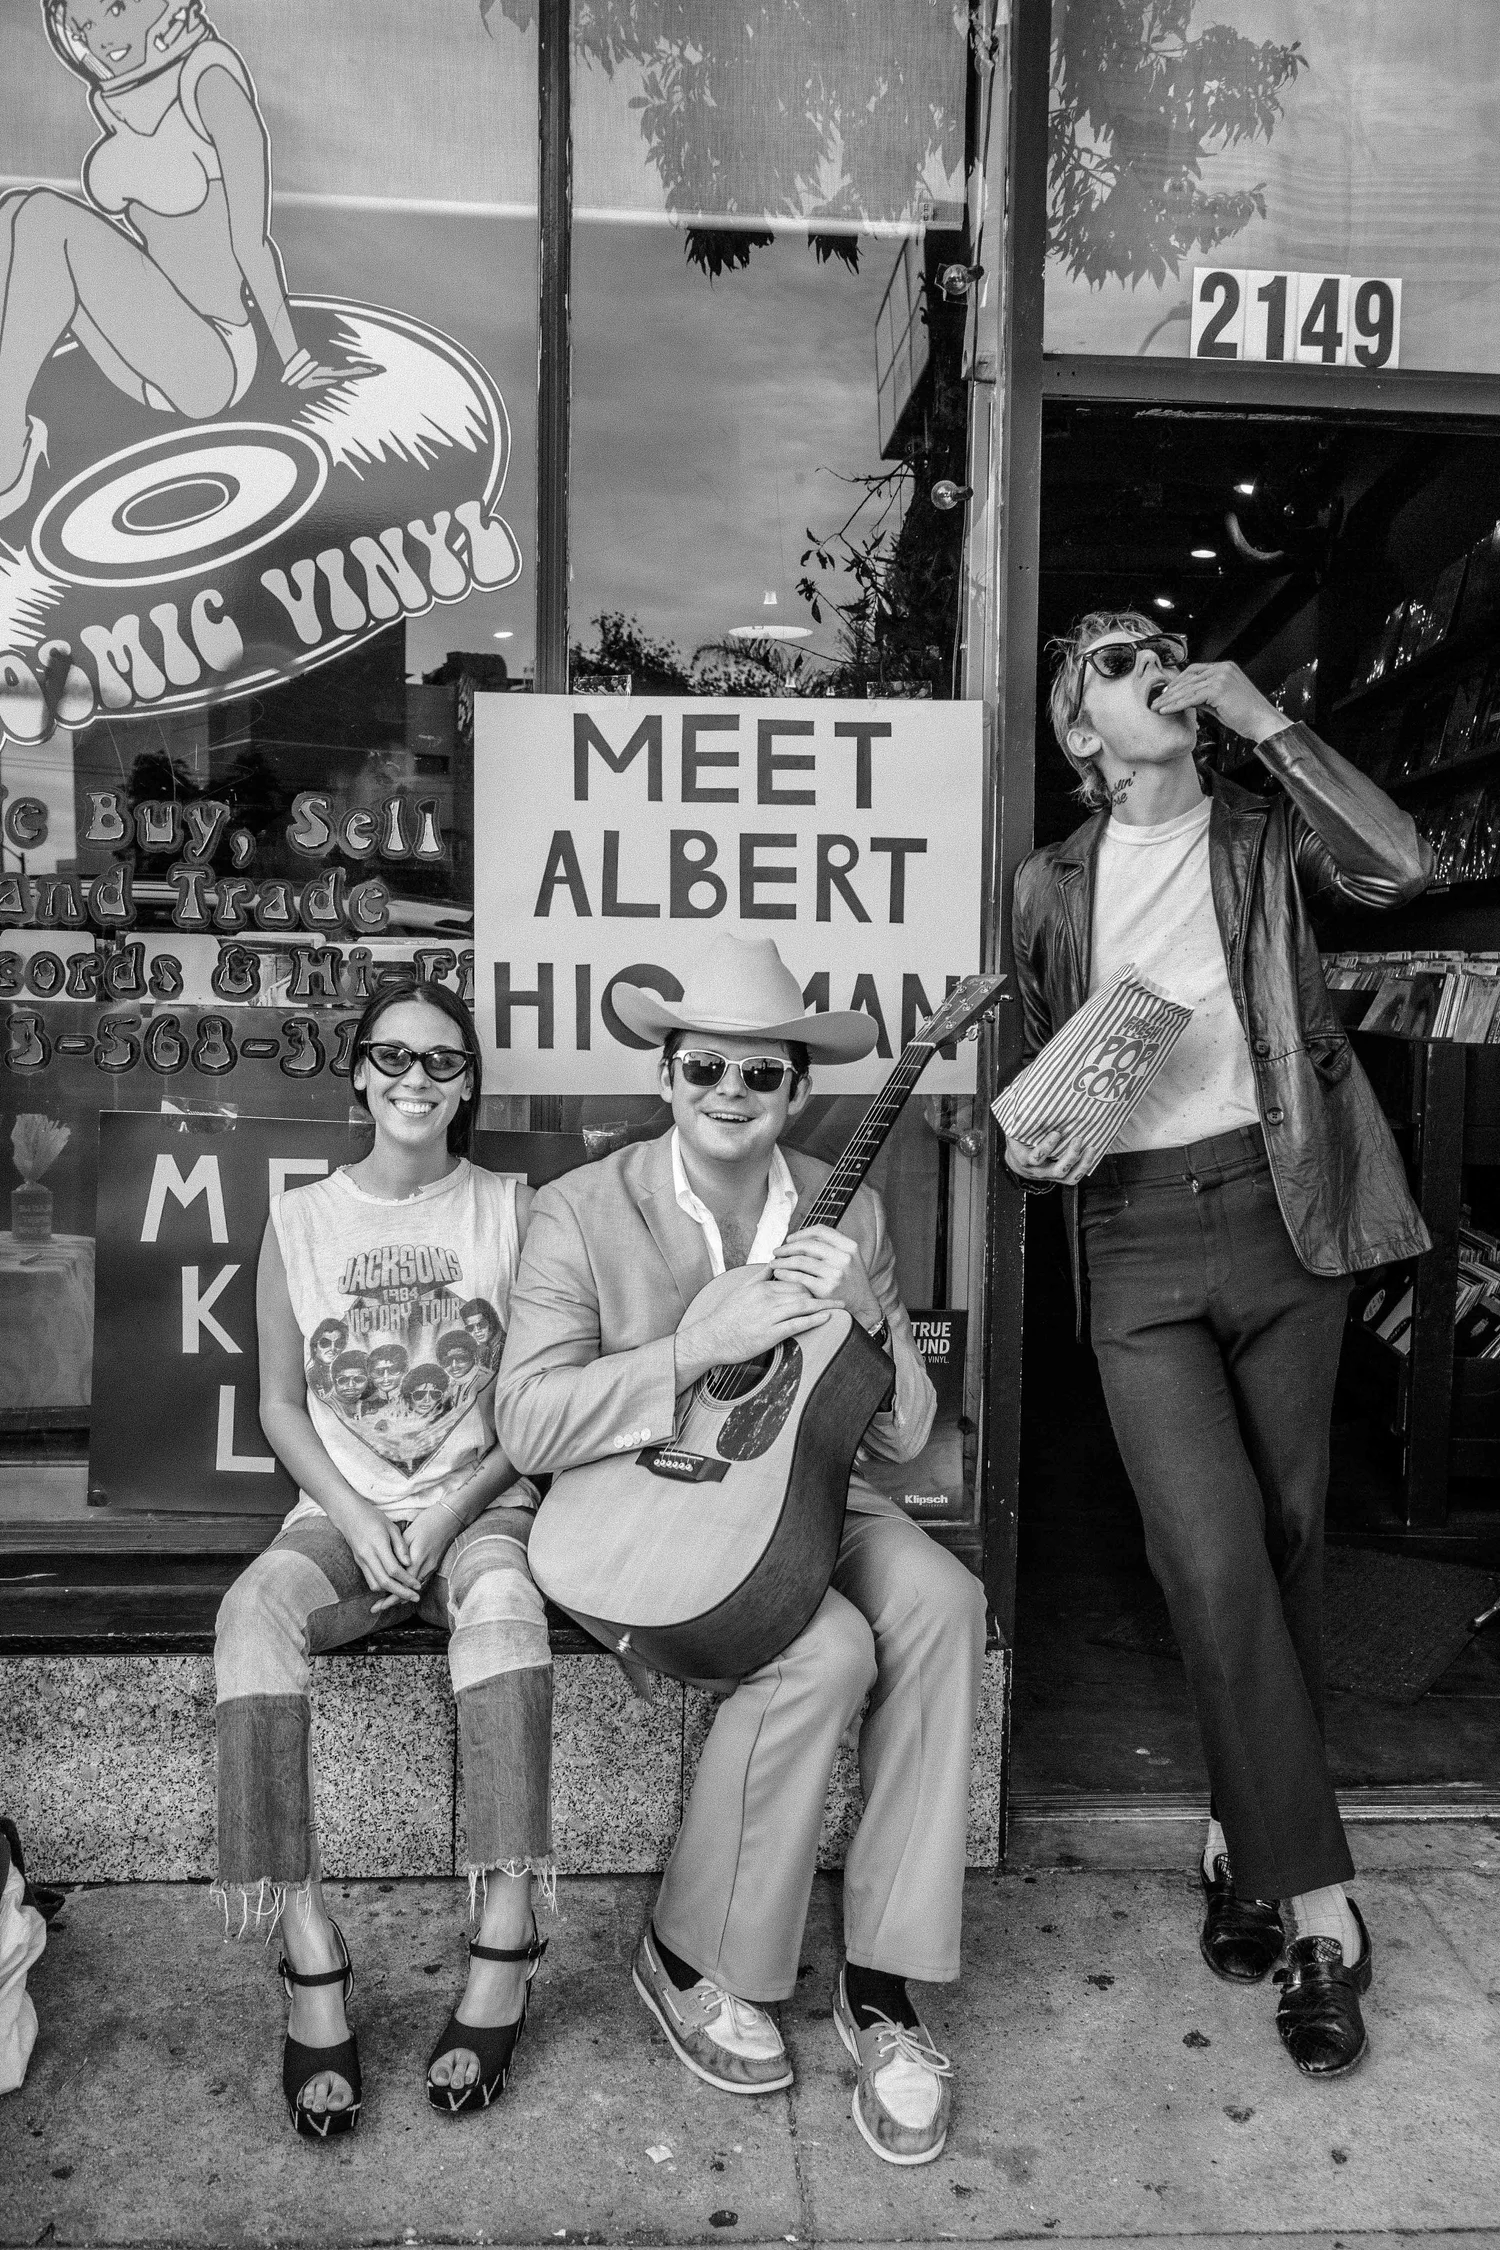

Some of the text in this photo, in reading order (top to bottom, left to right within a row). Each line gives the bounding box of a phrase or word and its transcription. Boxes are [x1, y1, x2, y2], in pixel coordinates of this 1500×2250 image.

[1197, 272, 1395, 368] 2149
[261, 500, 516, 645] VINYL
[573, 712, 892, 809] MEET
[82, 790, 252, 860] Buy,
[293, 796, 443, 855] Sell
[172, 868, 385, 924] Trade
[533, 829, 928, 924] ALBERT
[1123, 1015, 1162, 1041] FRESH
[1093, 1035, 1160, 1075] POP
[1072, 1064, 1145, 1102] CORN
[338, 1244, 463, 1294] JACKSONS
[382, 1286, 419, 1302] 1984
[419, 1297, 460, 1326] TOUR
[910, 1321, 952, 1337] TRUE
[904, 1494, 949, 1506] Klipsch
